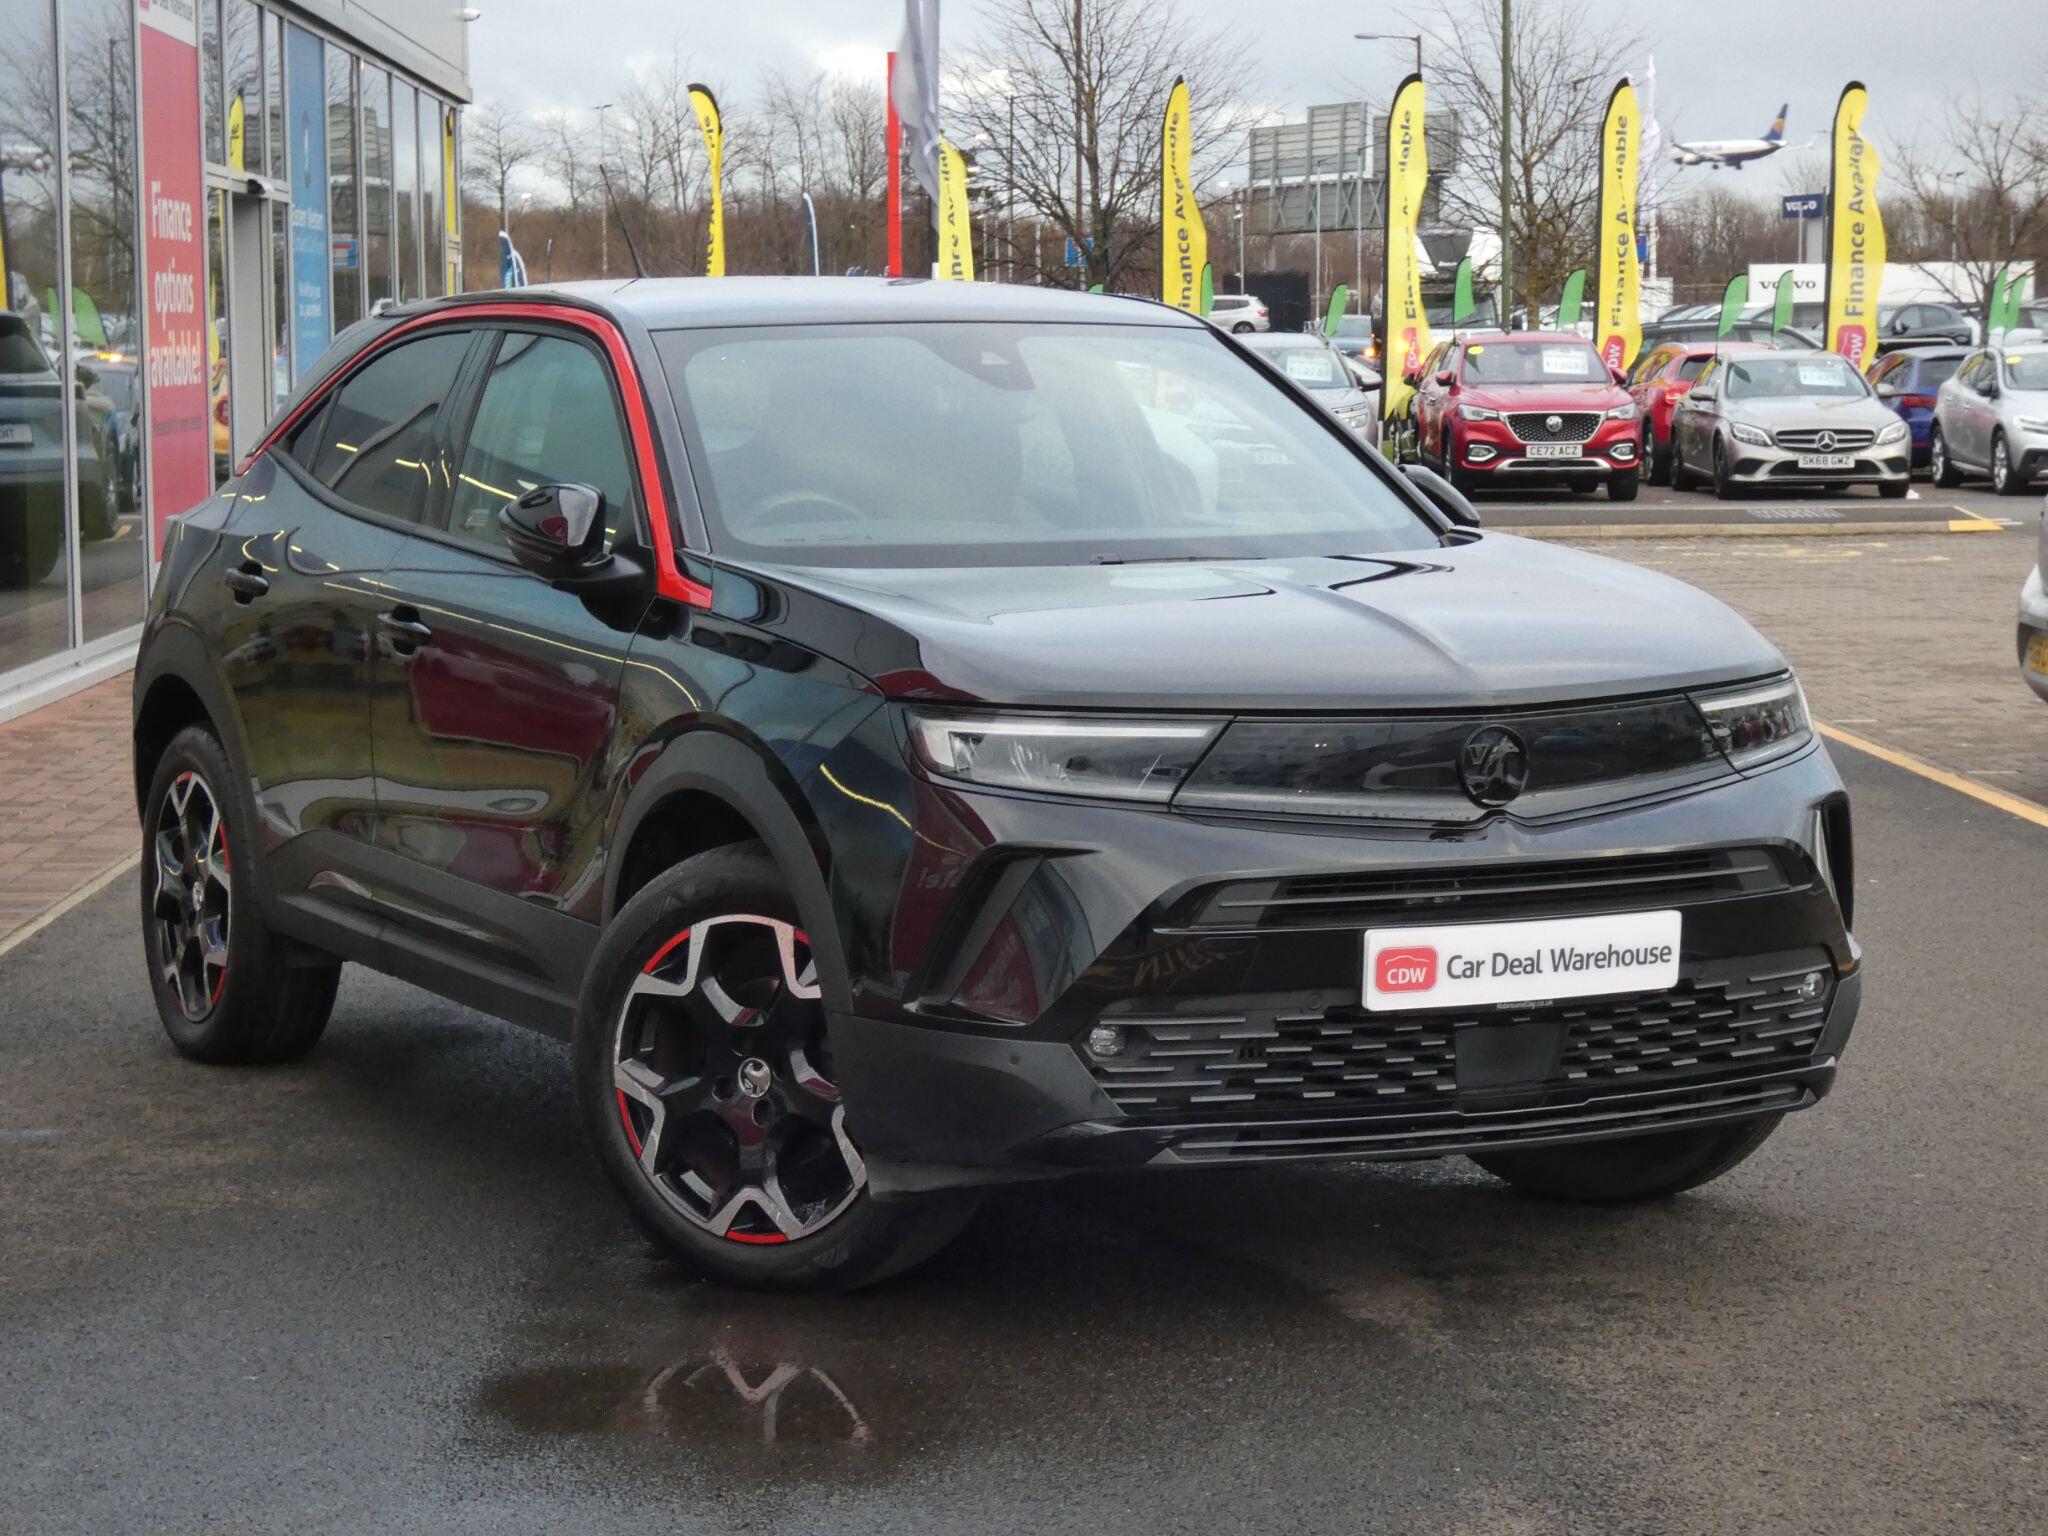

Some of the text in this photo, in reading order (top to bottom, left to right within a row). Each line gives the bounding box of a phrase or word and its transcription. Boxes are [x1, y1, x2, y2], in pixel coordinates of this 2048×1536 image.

[151, 180, 193, 243] Finance
[1177, 227, 1194, 308] inance
[1760, 280, 1817, 290] VOVO
[1844, 221, 1865, 318] Finance
[154, 257, 195, 331] options
[1606, 343, 1622, 369] DW
[1529, 446, 1578, 457] CE72 ACZ
[1802, 456, 1829, 466] SK68
[1386, 943, 1672, 986] CDW Car Deal Warehouse
